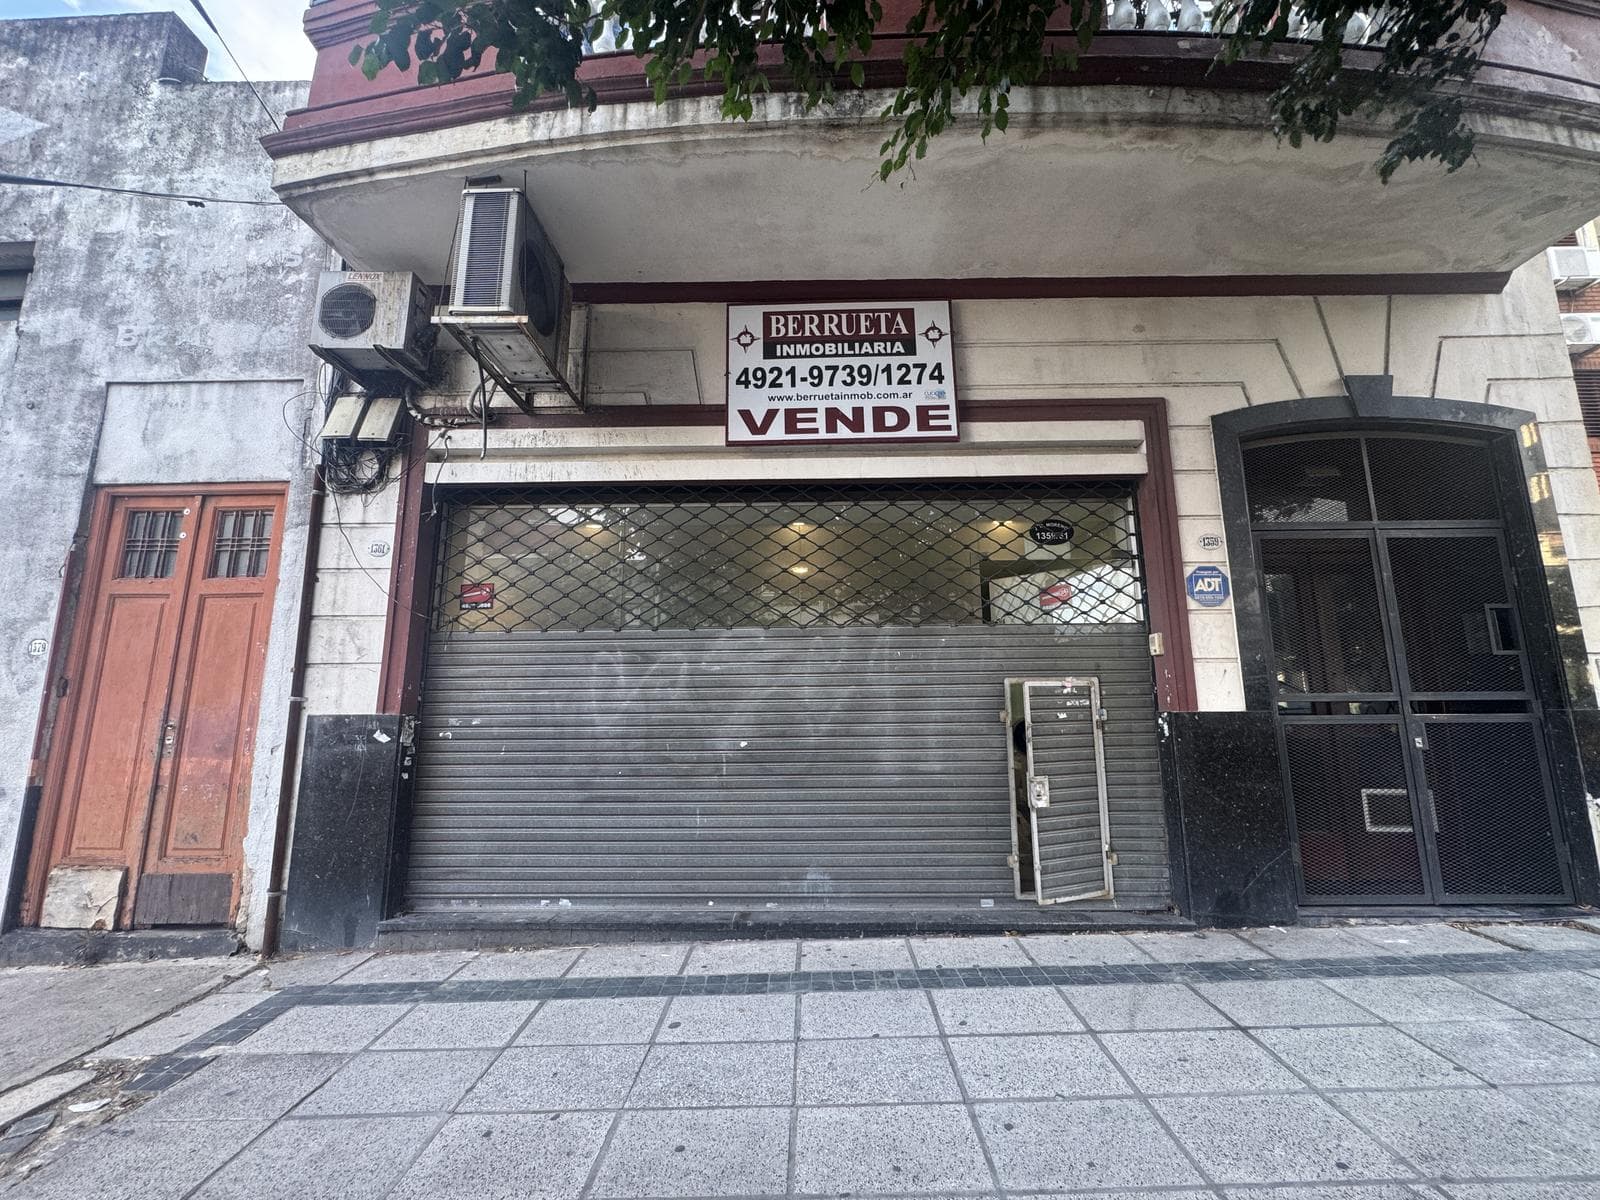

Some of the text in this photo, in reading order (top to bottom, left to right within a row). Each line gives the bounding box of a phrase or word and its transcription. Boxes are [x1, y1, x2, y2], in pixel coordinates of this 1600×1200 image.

[348, 272, 381, 280] LENNOX
[769, 312, 910, 338] BERRUETA
[776, 341, 906, 356] INMOBILIARIA
[736, 362, 944, 389] 4921-9739/1274
[767, 390, 913, 402] www.berruetainmob.com.ar
[737, 404, 953, 436] VENDE
[1194, 577, 1222, 592] ADT
